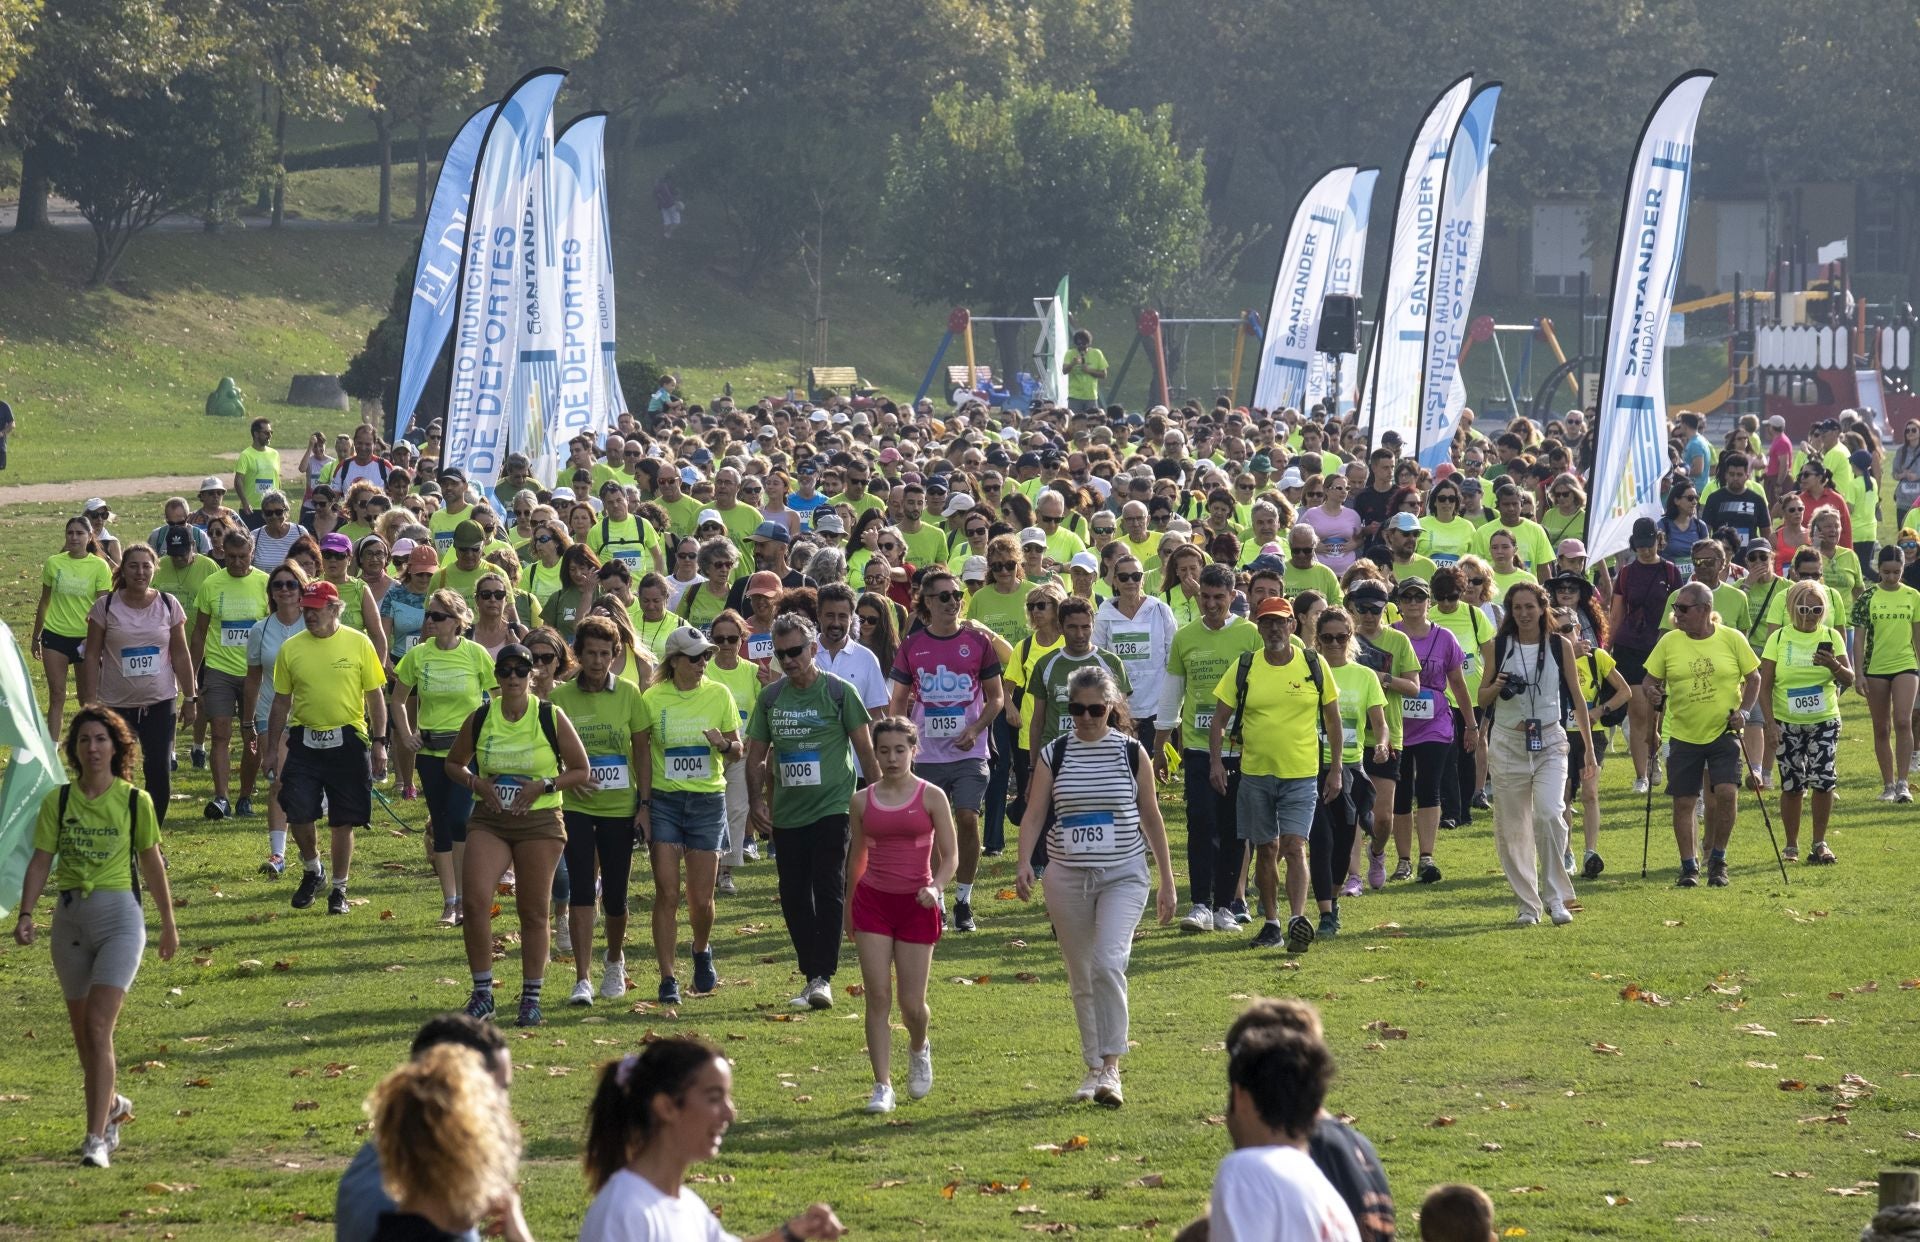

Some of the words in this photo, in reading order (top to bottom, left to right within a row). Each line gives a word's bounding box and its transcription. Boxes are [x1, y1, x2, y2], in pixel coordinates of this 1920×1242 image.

[1410, 176, 1434, 316] SANTANDER
[1435, 218, 1456, 323] MUNICIPAL
[413, 260, 459, 309] EL
[461, 224, 487, 347] MUNICIPAL
[1625, 187, 1663, 377] SANTANDER
[1286, 233, 1318, 347] SANTANDER
[562, 238, 588, 385] DEPORTES
[476, 226, 517, 416] DEPORTES
[1297, 308, 1311, 349] CIUDAD
[1641, 311, 1655, 378] CIUDAD
[450, 356, 477, 468] NSTITUTO
[564, 391, 591, 428] DE
[467, 428, 500, 473] DE
[1872, 613, 1911, 621] Bezana
[227, 629, 249, 640] 0774
[755, 640, 774, 652] 073
[1114, 643, 1137, 654] 1236
[130, 655, 153, 670] 0197
[1403, 699, 1428, 712] 0264
[1795, 695, 1820, 709] 0635
[782, 708, 818, 718] marcha
[579, 723, 613, 732] marcha
[771, 717, 798, 726] contra
[932, 717, 958, 730] 0135
[311, 729, 335, 741] 0823
[778, 727, 812, 736] cáncer
[673, 757, 703, 772] 0004
[784, 763, 812, 778] 0006
[590, 767, 620, 781] 0002
[74, 825, 120, 837] marcha
[1071, 826, 1104, 844] 0763
